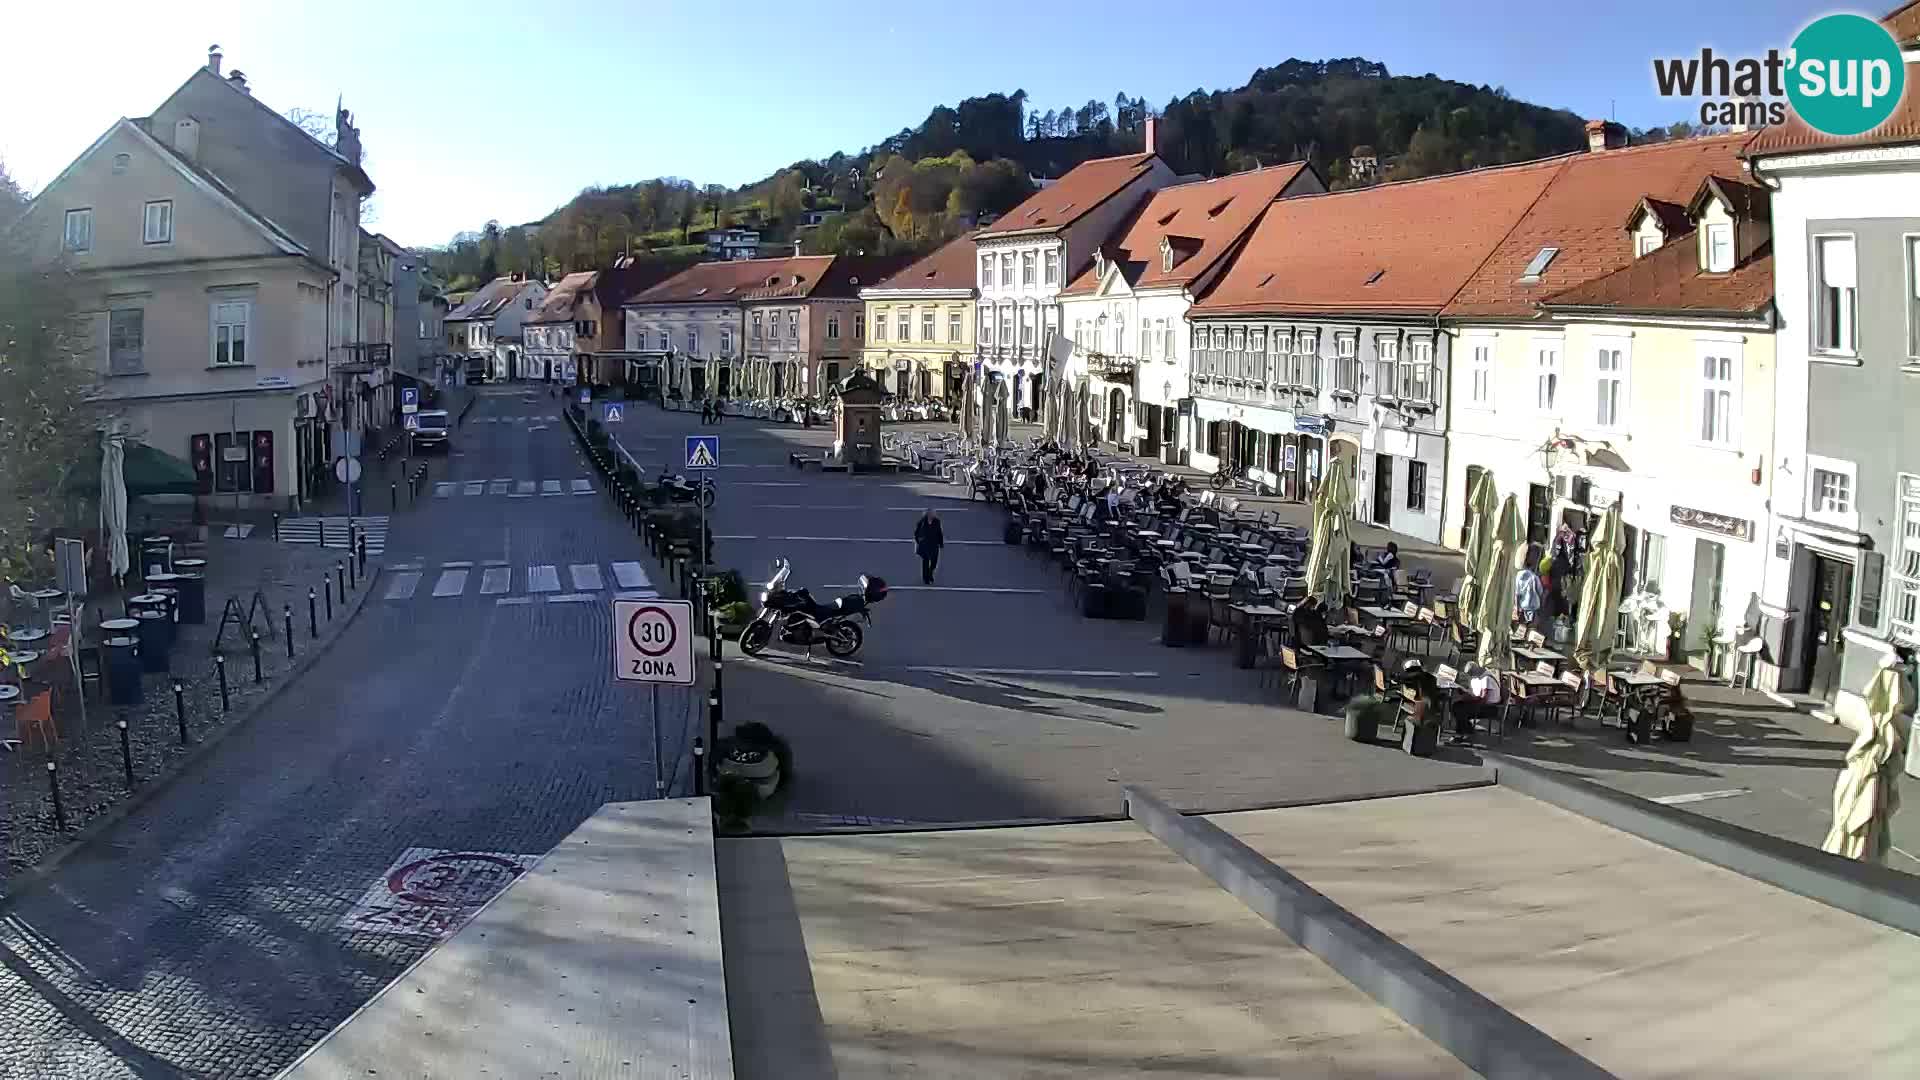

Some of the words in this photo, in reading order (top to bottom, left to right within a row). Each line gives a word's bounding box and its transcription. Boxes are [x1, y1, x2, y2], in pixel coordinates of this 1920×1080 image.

[405, 392, 414, 402] P
[641, 622, 665, 643] 30
[631, 659, 676, 677] ZONA
